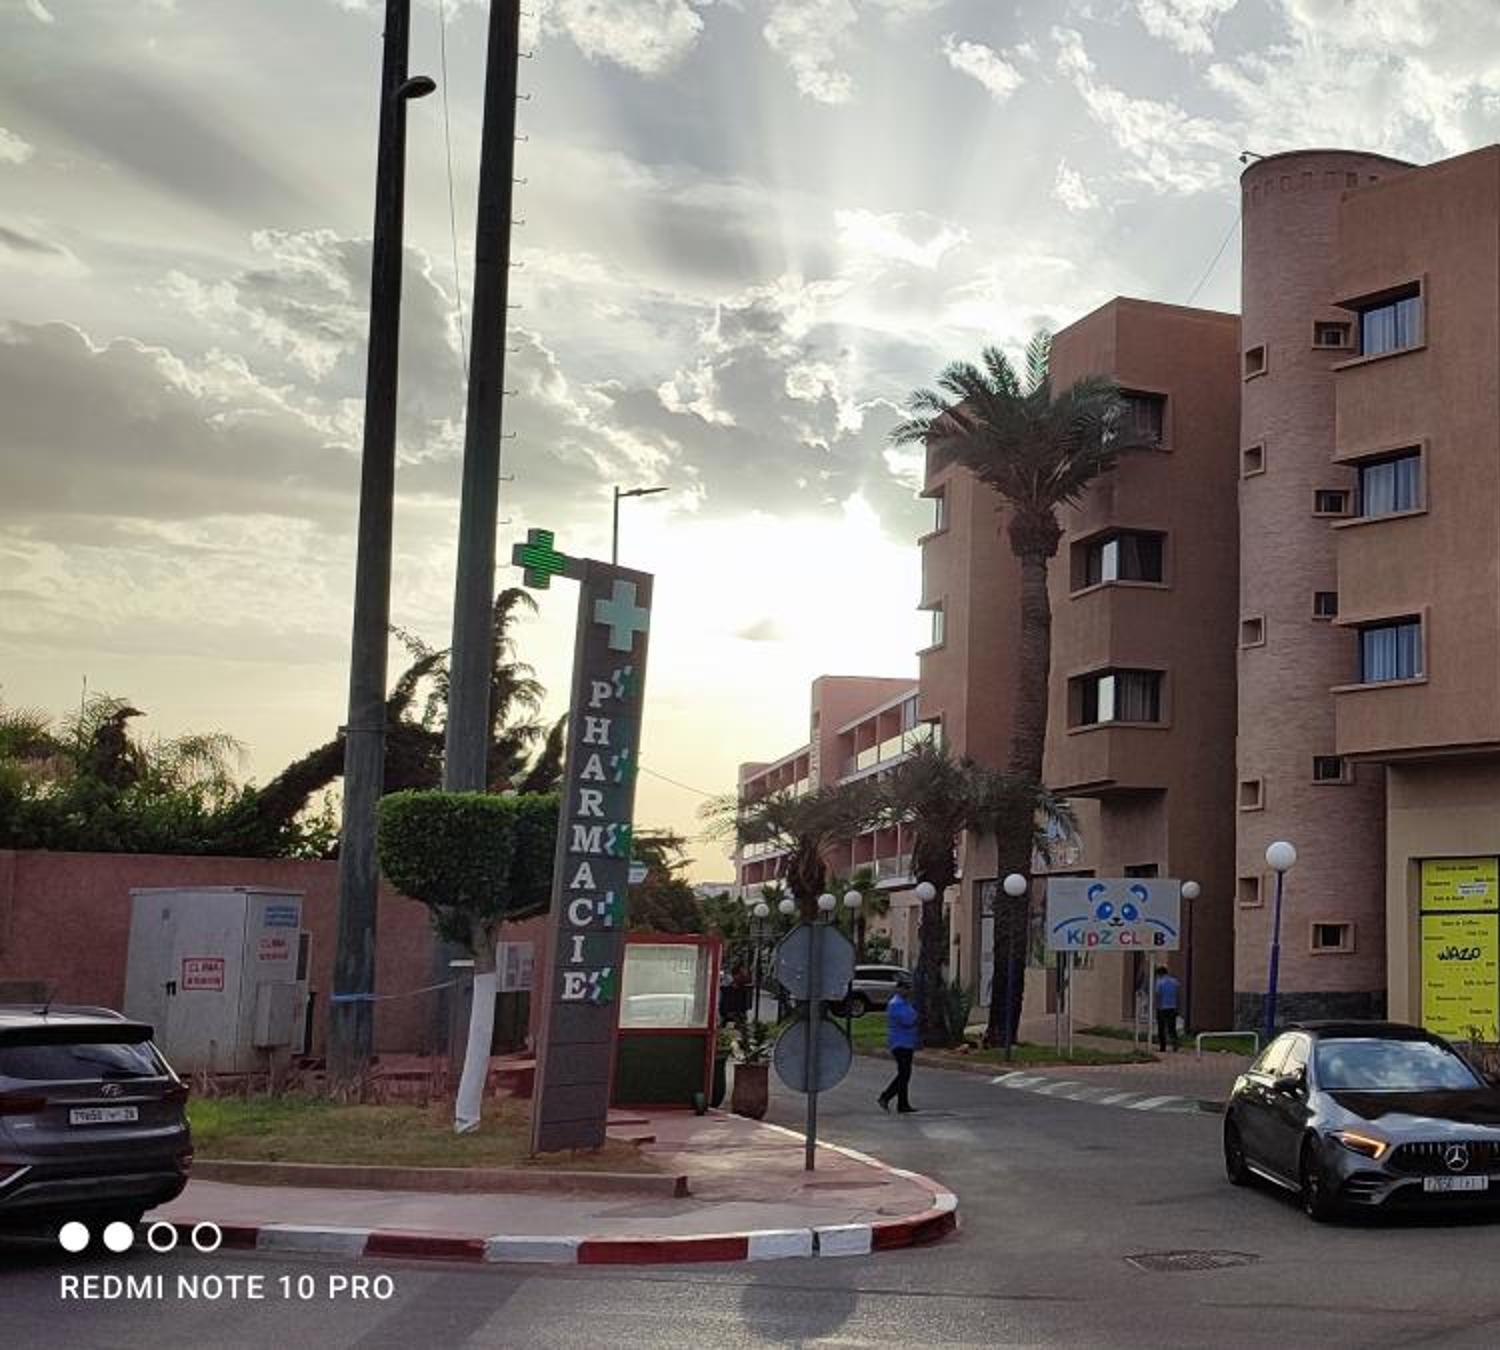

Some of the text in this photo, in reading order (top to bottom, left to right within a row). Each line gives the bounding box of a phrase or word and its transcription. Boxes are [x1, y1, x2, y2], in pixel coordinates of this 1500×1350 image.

[561, 681, 612, 1000] PHARMACIE
[1067, 928, 1113, 946] KIDZ
[1438, 946, 1481, 960] WAZO
